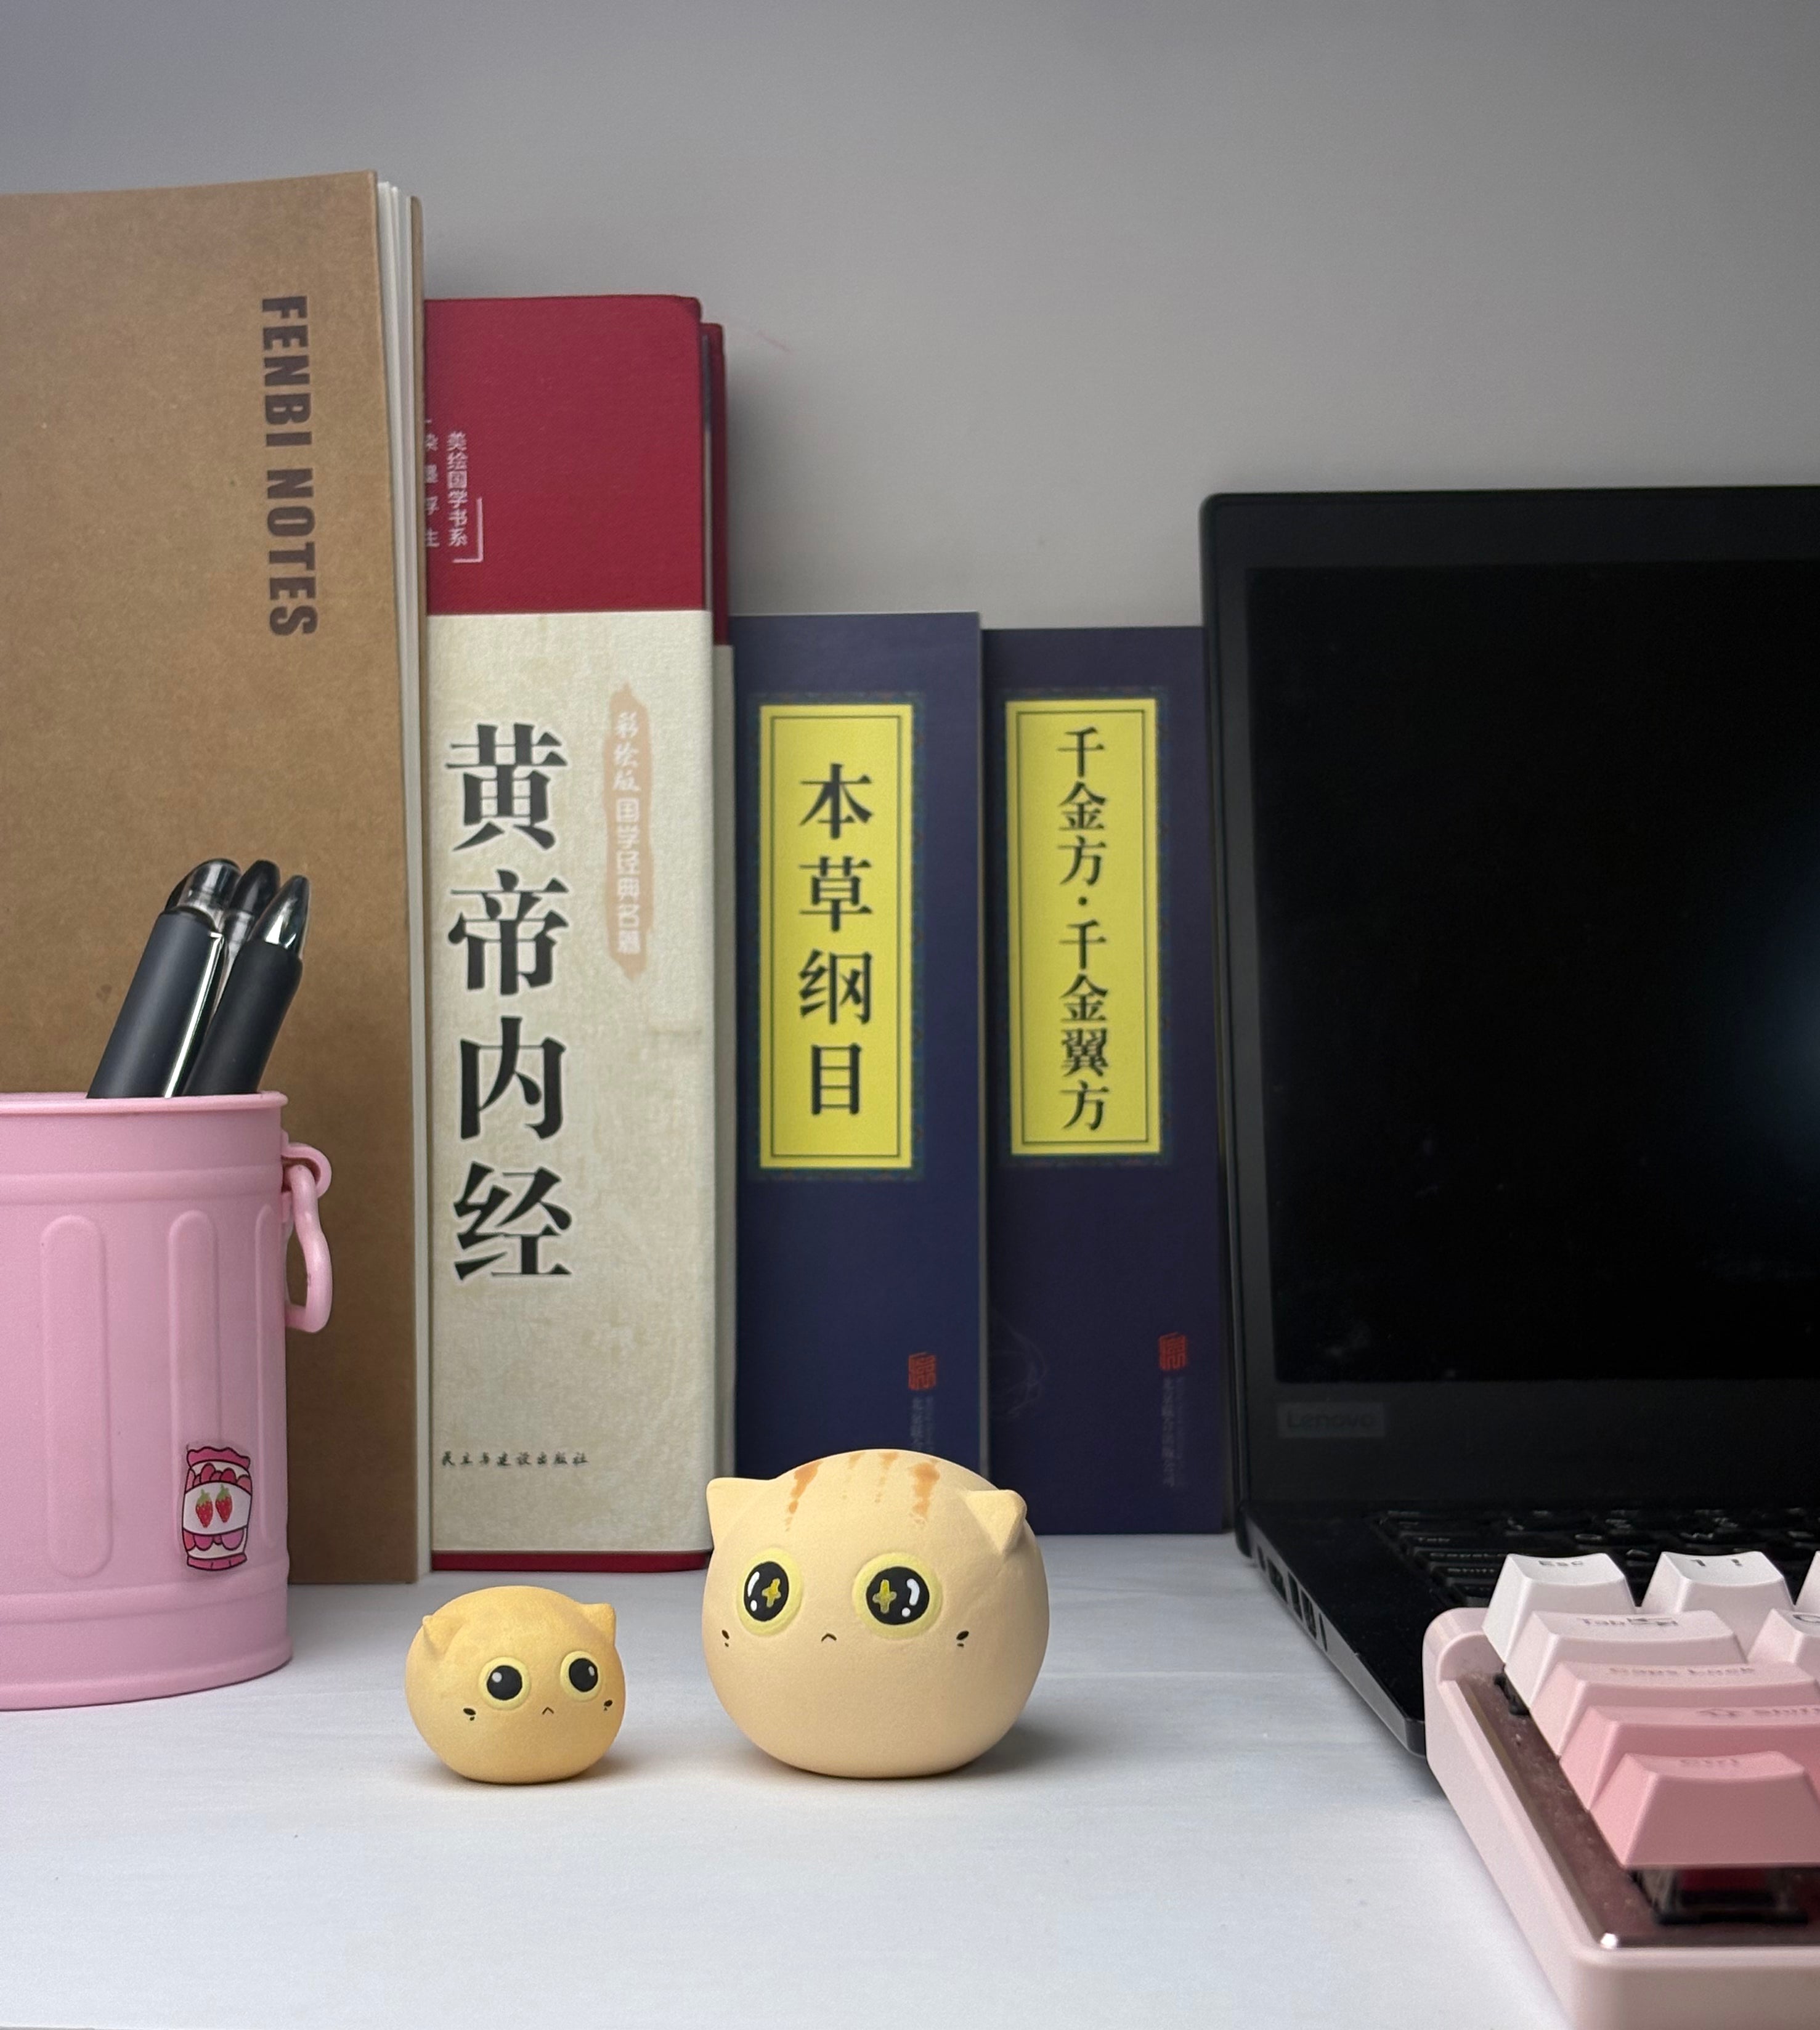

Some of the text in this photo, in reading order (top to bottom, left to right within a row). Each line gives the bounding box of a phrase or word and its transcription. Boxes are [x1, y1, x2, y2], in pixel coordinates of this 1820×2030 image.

[261, 295, 319, 636] FENBI NOTES
[446, 431, 468, 548] 美绘国学书系
[445, 723, 574, 1282] 黄帝内经
[798, 761, 874, 1116] 本草纲目
[1057, 726, 1110, 1131] 千金方·千金翼方
[1538, 1559, 1585, 1568] Esc
